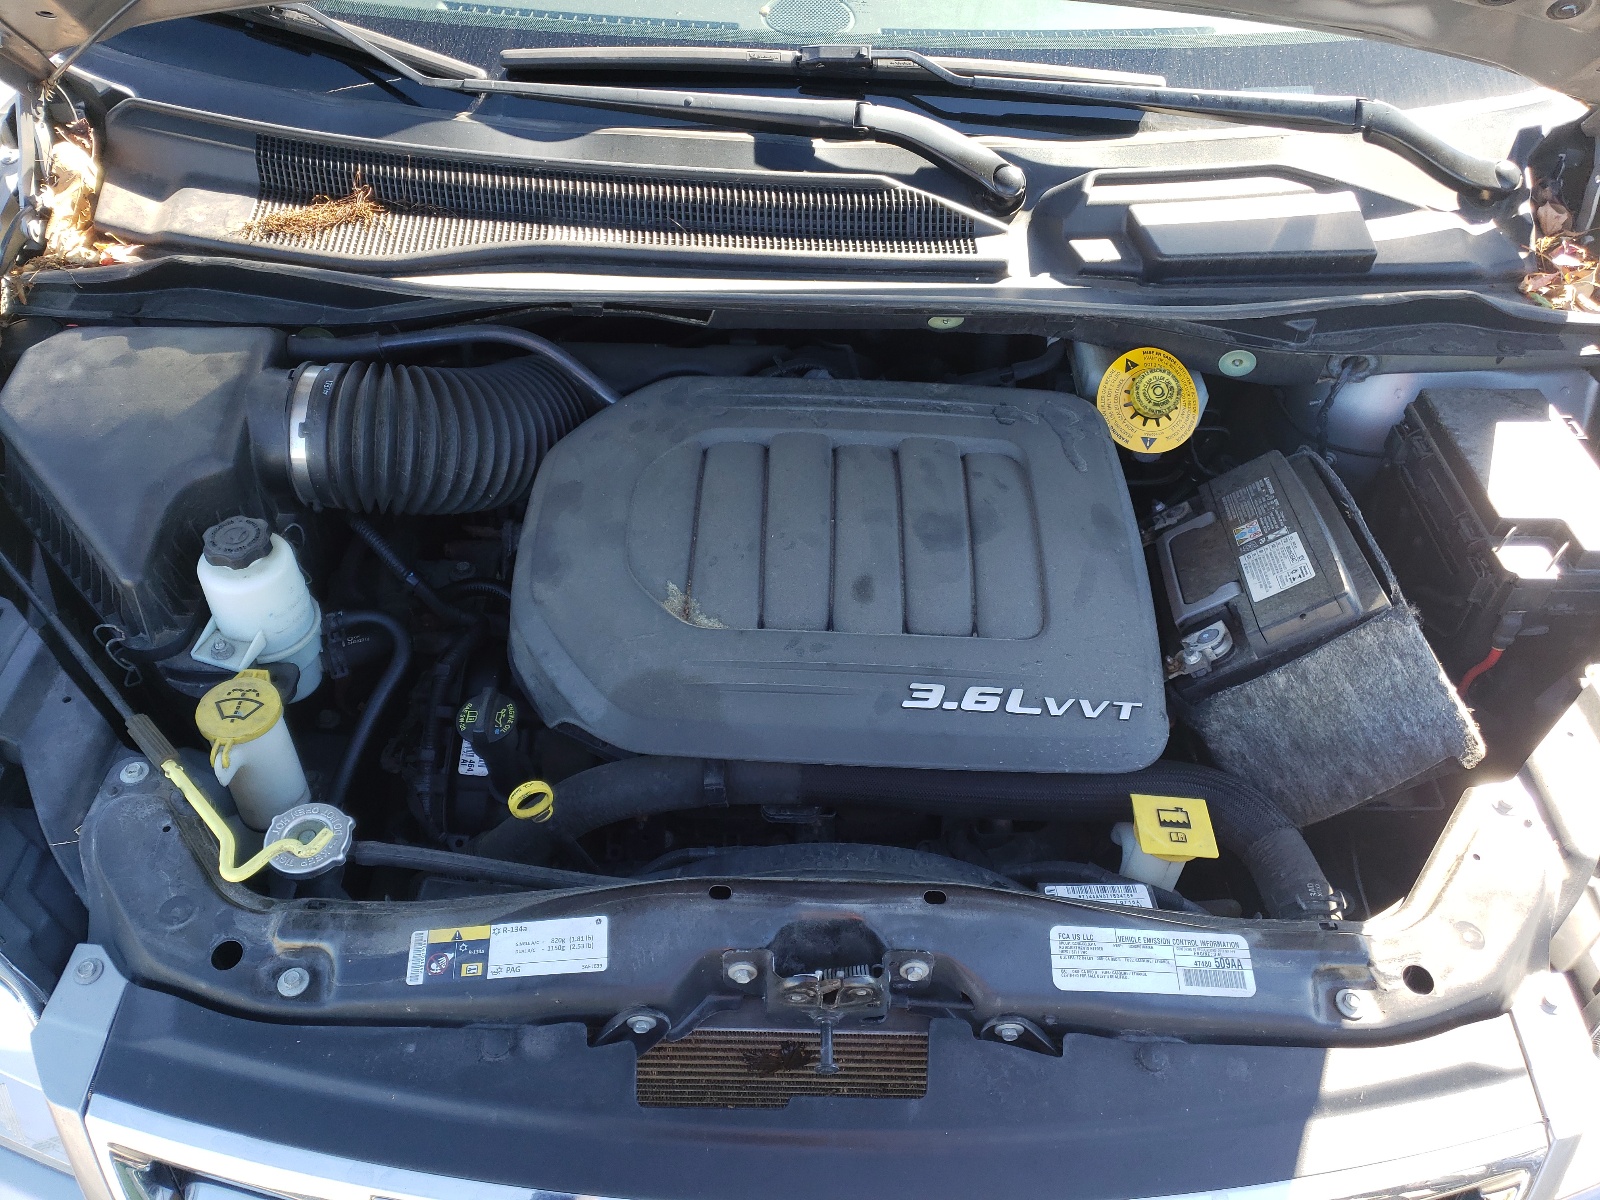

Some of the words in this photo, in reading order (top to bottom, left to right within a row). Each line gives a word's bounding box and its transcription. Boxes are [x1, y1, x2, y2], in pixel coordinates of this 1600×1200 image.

[500, 724, 510, 733] OIL
[291, 807, 319, 819] OPEN
[321, 809, 338, 824] NOT
[272, 817, 290, 835] HOT
[334, 824, 342, 835] DO
[300, 850, 330, 866] KEEP
[1117, 935, 1141, 943] VEHICLE
[1172, 938, 1198, 946] CONTROL
[1200, 940, 1240, 948] INFORMATION
[1214, 957, 1244, 969] 509AA
